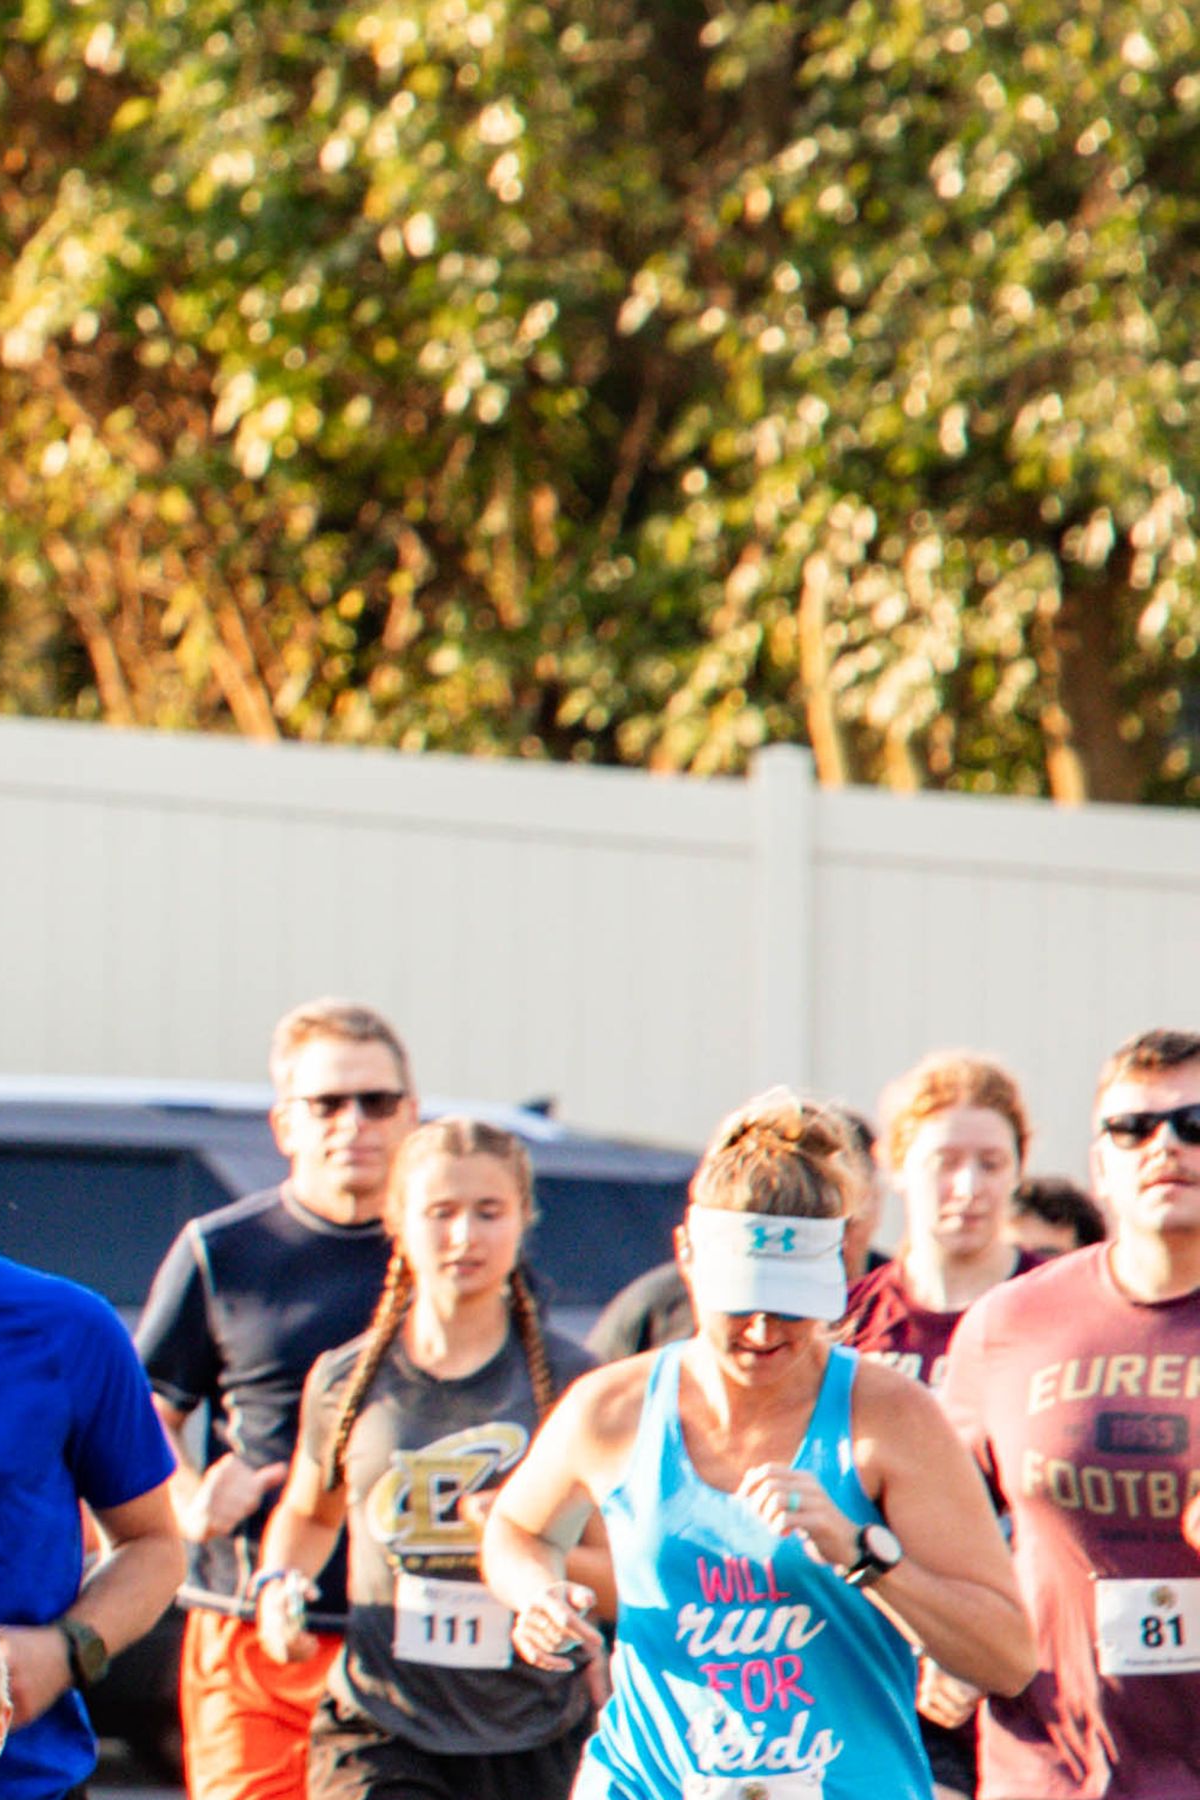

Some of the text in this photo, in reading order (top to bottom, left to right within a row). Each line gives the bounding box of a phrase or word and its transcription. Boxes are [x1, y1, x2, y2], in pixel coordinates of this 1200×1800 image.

[1023, 1449, 1200, 1518] FOOTB
[696, 1555, 791, 1603] WILL
[423, 1614, 478, 1645] 111
[675, 1602, 827, 1657] run
[1140, 1614, 1184, 1647] 81
[699, 1654, 815, 1713] FOR
